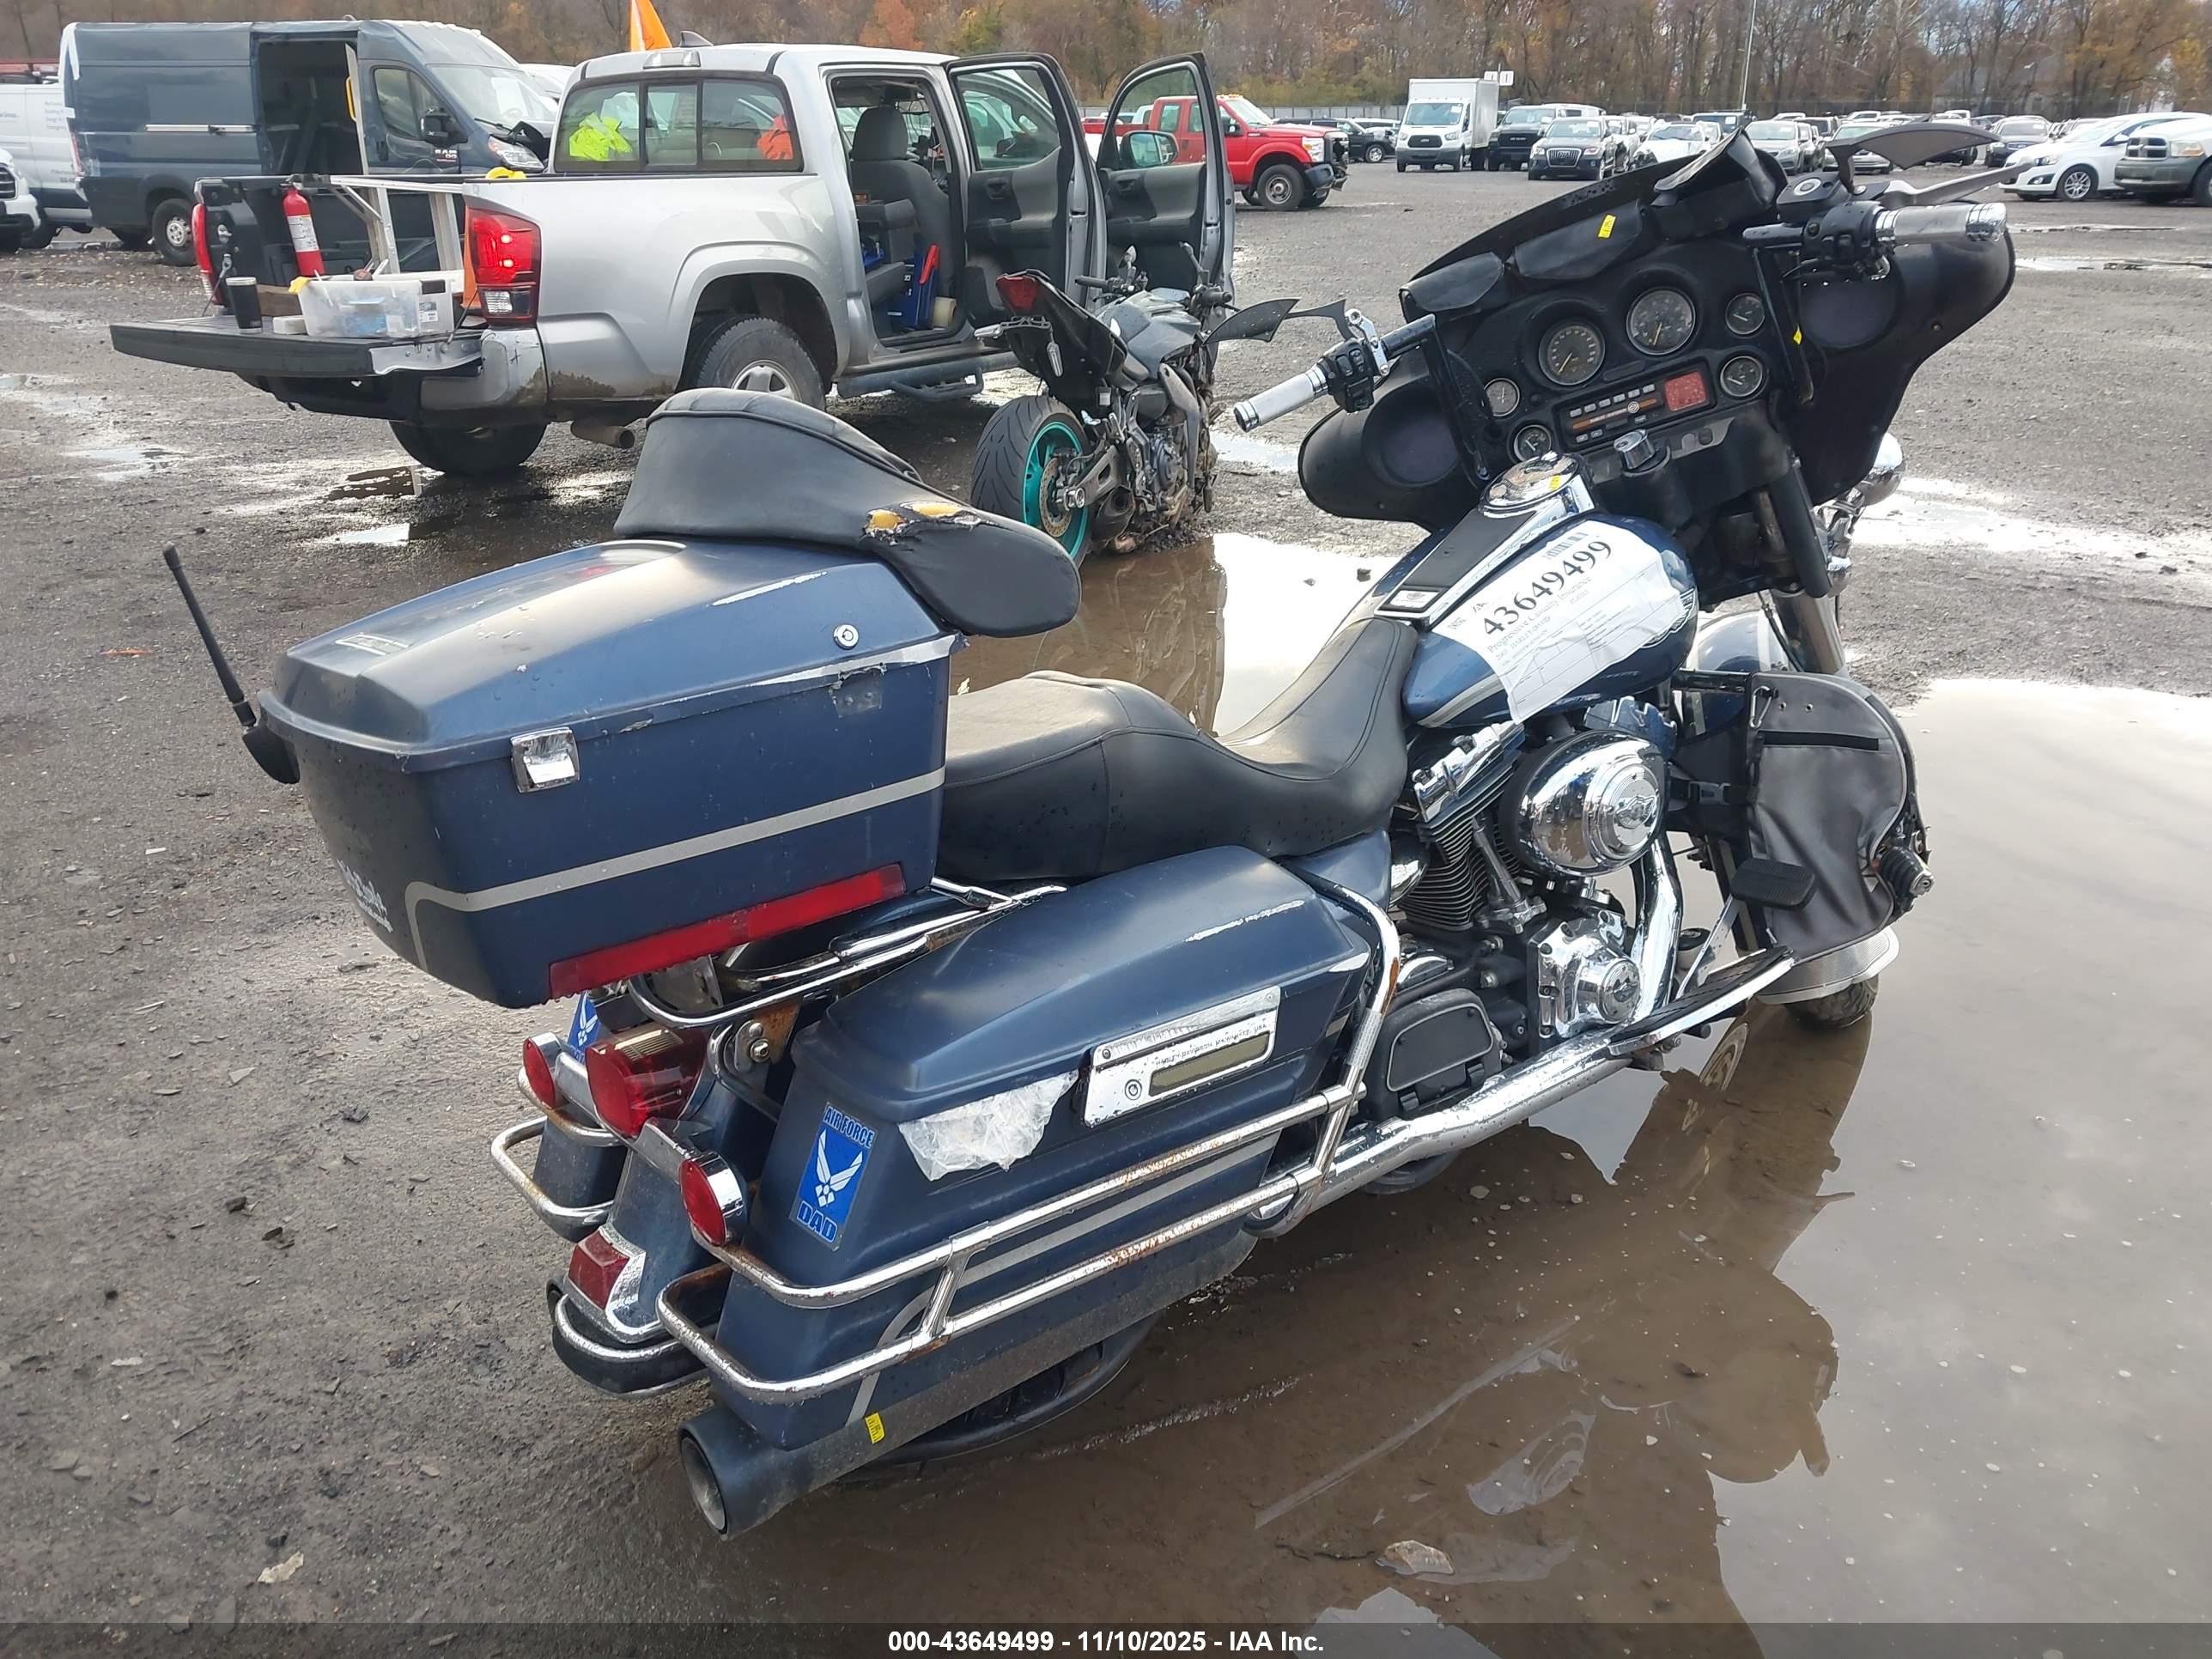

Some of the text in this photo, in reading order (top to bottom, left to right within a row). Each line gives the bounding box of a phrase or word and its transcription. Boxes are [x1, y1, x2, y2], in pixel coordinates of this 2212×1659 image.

[1484, 541, 1612, 635] 43649499
[823, 1105, 875, 1149] AIR FORCE
[797, 1200, 838, 1243] DAD
